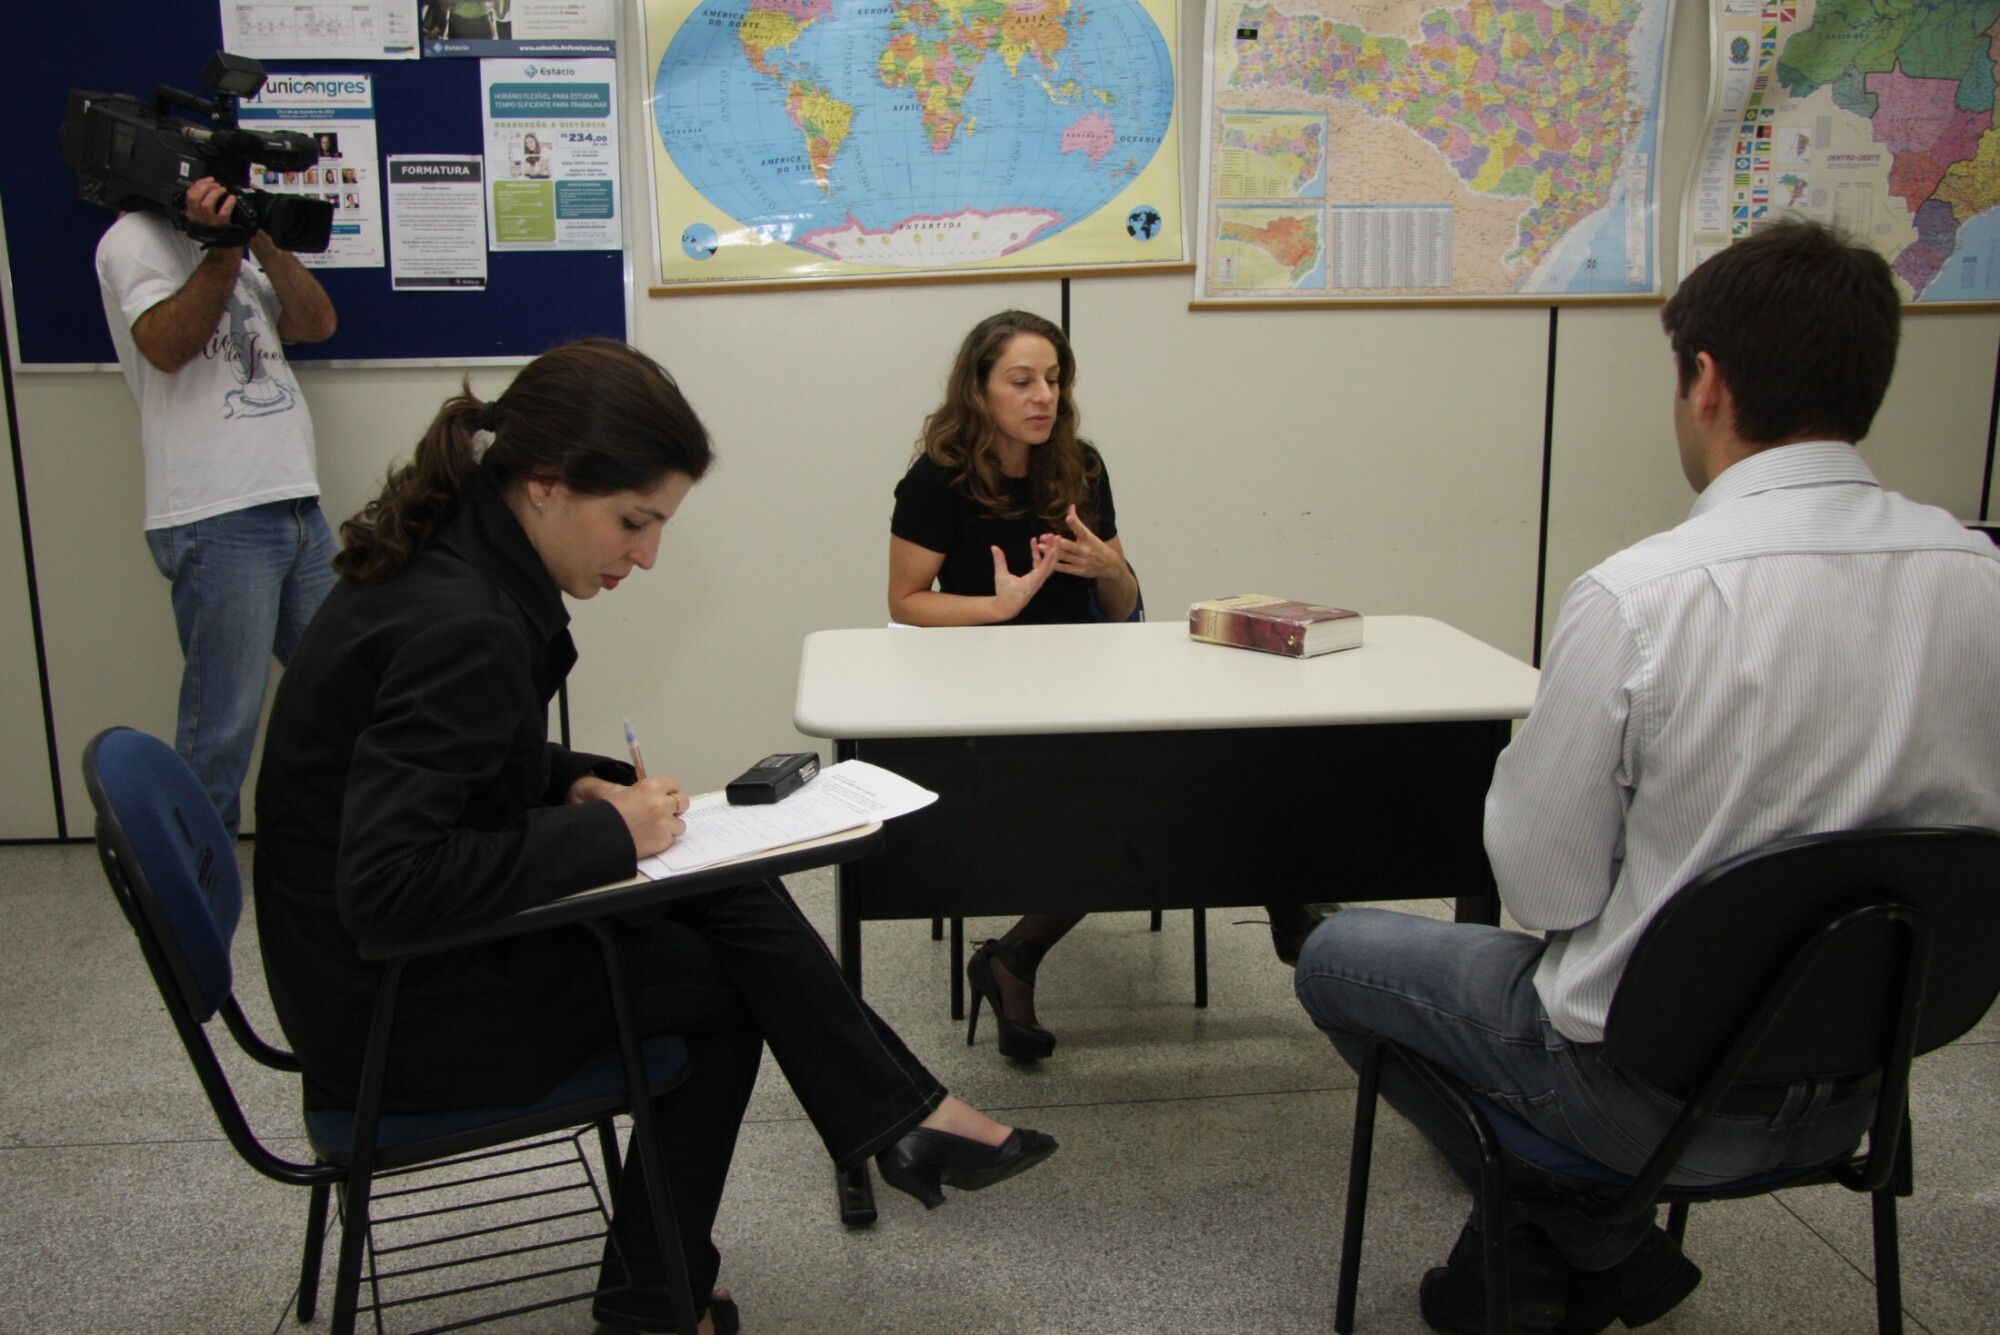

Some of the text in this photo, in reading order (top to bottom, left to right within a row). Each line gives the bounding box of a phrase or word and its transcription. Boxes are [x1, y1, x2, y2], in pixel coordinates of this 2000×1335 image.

[857, 7, 895, 16] EUROPA
[728, 20, 760, 29] NORTE
[540, 67, 575, 76] Estácio
[494, 92, 522, 100] HORÁRIO
[523, 92, 551, 100] FLEXÍVEL
[494, 120, 547, 129] GRADUAÇÃO
[560, 120, 606, 128] DISTÂNCIA
[569, 133, 608, 143] 234,00
[1120, 135, 1161, 143] OCEANIA
[401, 166, 470, 175] FORMATURA
[777, 163, 812, 174] DO SUL
